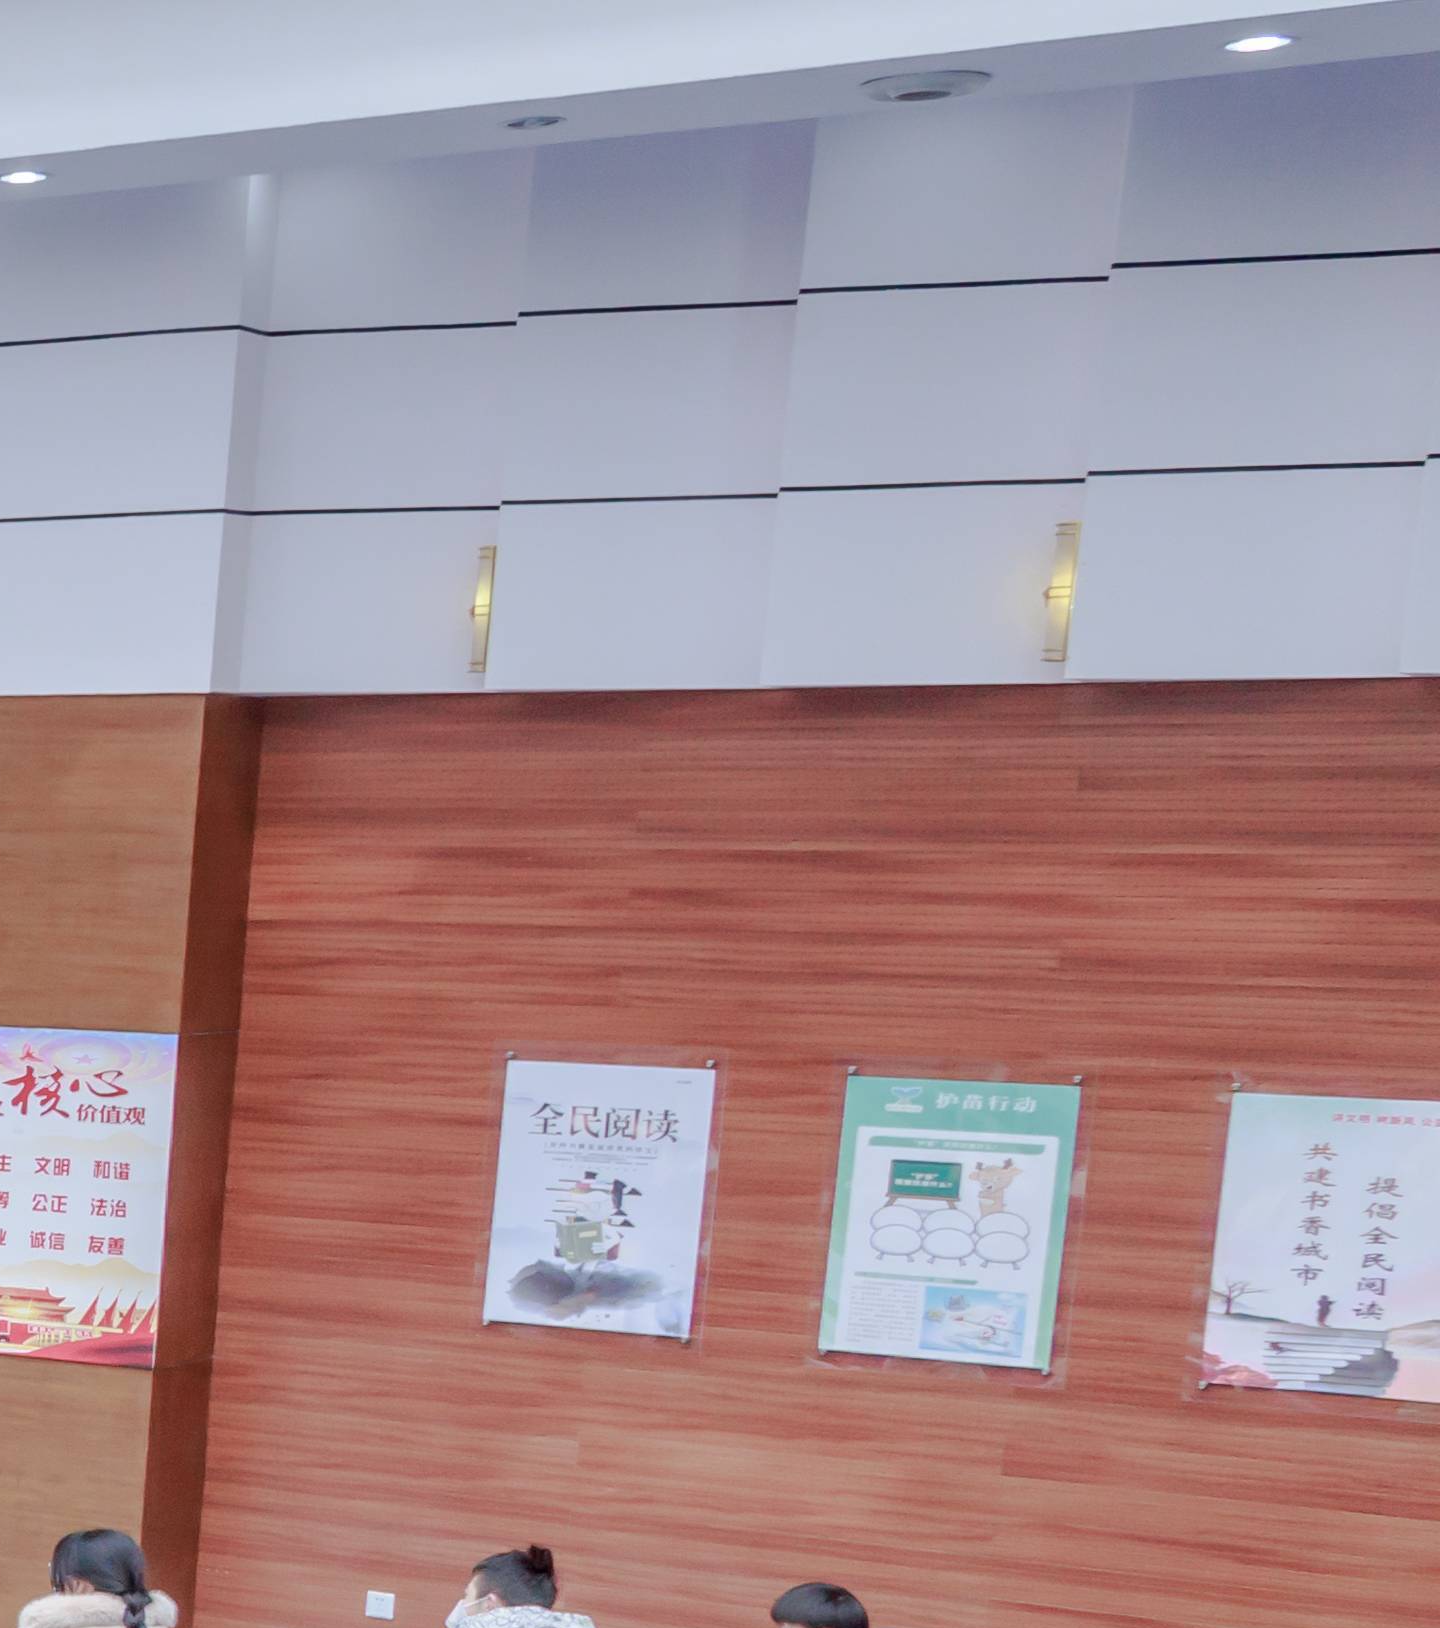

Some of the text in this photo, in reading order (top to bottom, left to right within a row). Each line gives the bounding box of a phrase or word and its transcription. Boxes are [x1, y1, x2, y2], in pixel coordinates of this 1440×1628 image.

[3, 1065, 128, 1119] 核心
[77, 1102, 146, 1126] 价值观
[936, 1092, 1037, 1113] 护苗行动
[528, 1102, 680, 1143] 全民阅读
[34, 1156, 71, 1177] 文明
[94, 1160, 131, 1181] 和谐
[32, 1194, 68, 1214] 公正
[90, 1198, 127, 1219] 法治
[1290, 1142, 1338, 1287] 共建书香城市
[30, 1231, 65, 1251] 诚信
[88, 1235, 125, 1256] 友善
[1352, 1176, 1405, 1321] 提倡全民阅读
